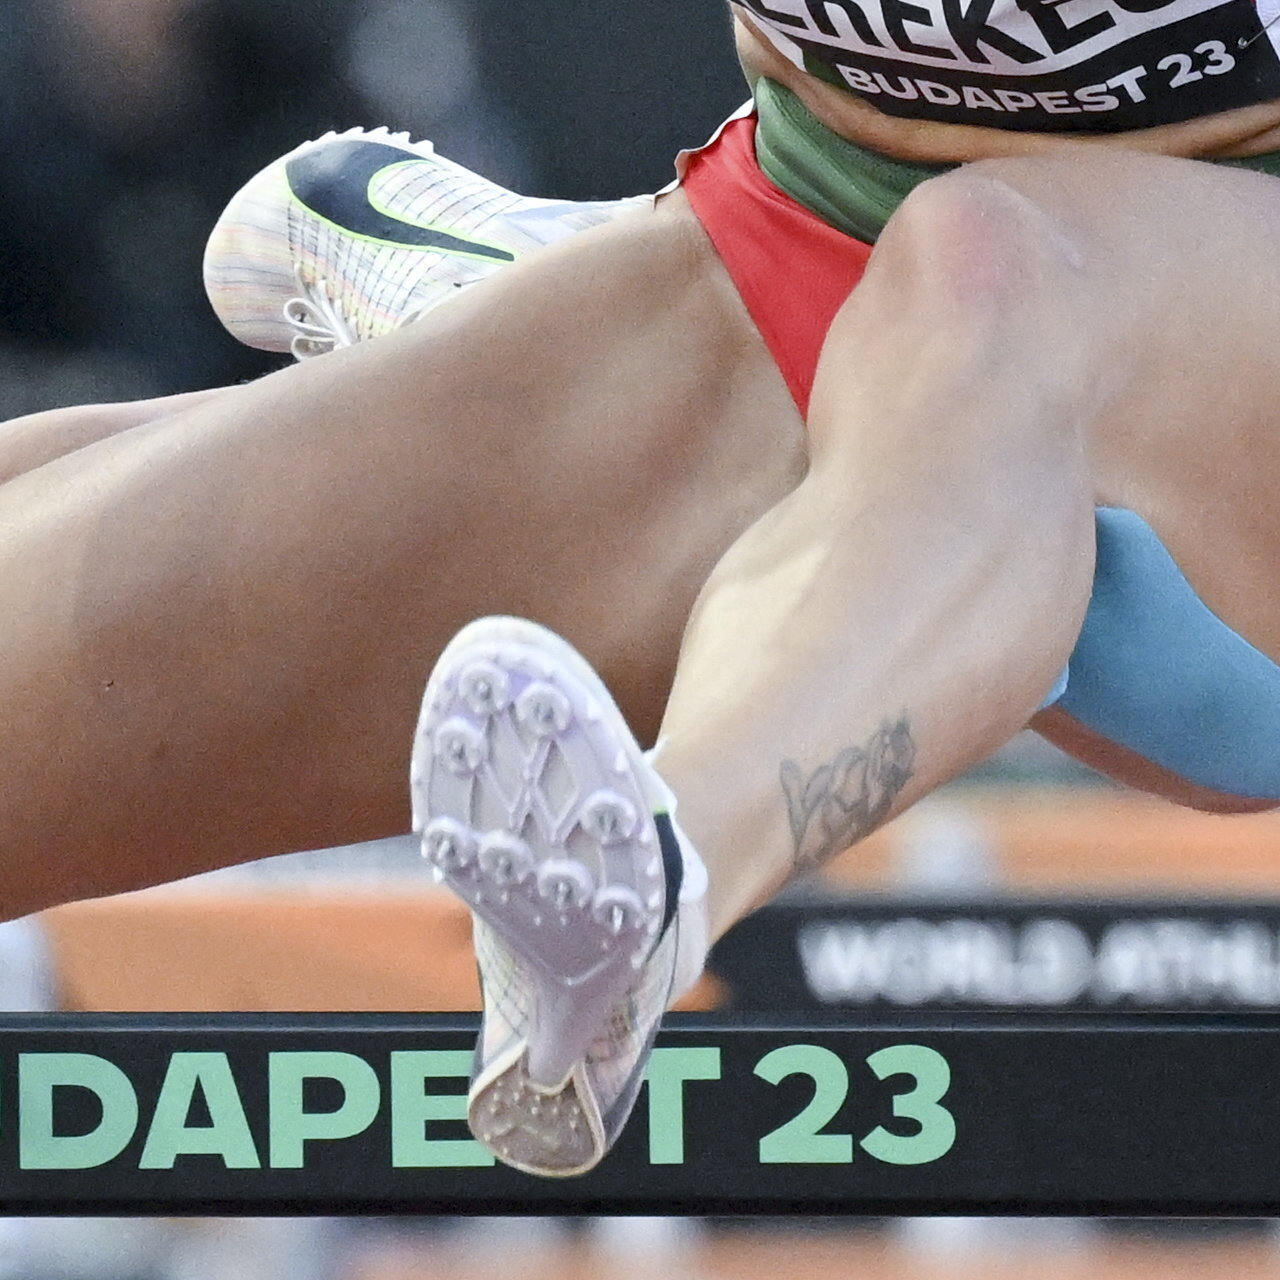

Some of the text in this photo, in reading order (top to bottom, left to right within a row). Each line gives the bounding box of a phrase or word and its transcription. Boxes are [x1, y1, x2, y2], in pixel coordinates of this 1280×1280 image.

[835, 39, 1236, 114] BUDAPEST 23
[797, 919, 1094, 1007] WORLD
[756, 1043, 956, 1165] 23
